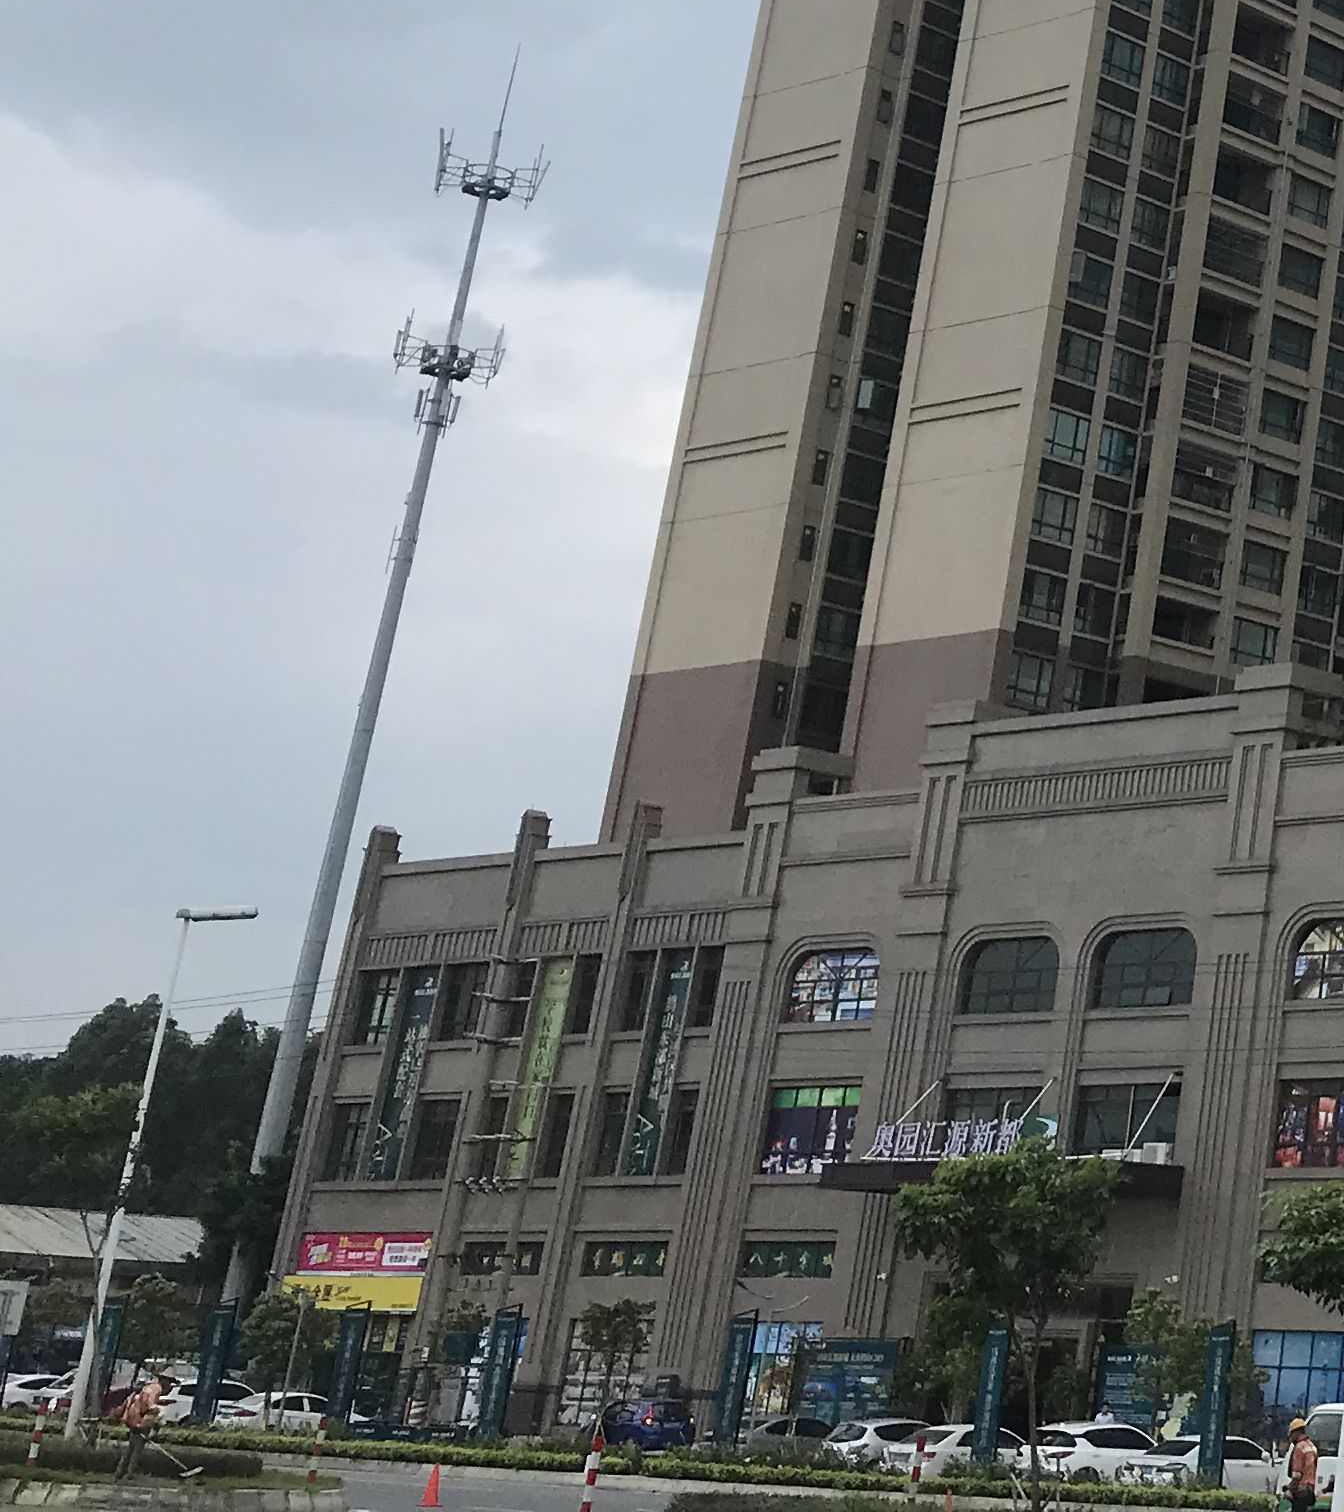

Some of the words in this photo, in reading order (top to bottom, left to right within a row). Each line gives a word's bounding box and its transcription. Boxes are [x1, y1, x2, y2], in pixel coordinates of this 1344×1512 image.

[868, 1118, 1024, 1157] 奥园汇源新都
